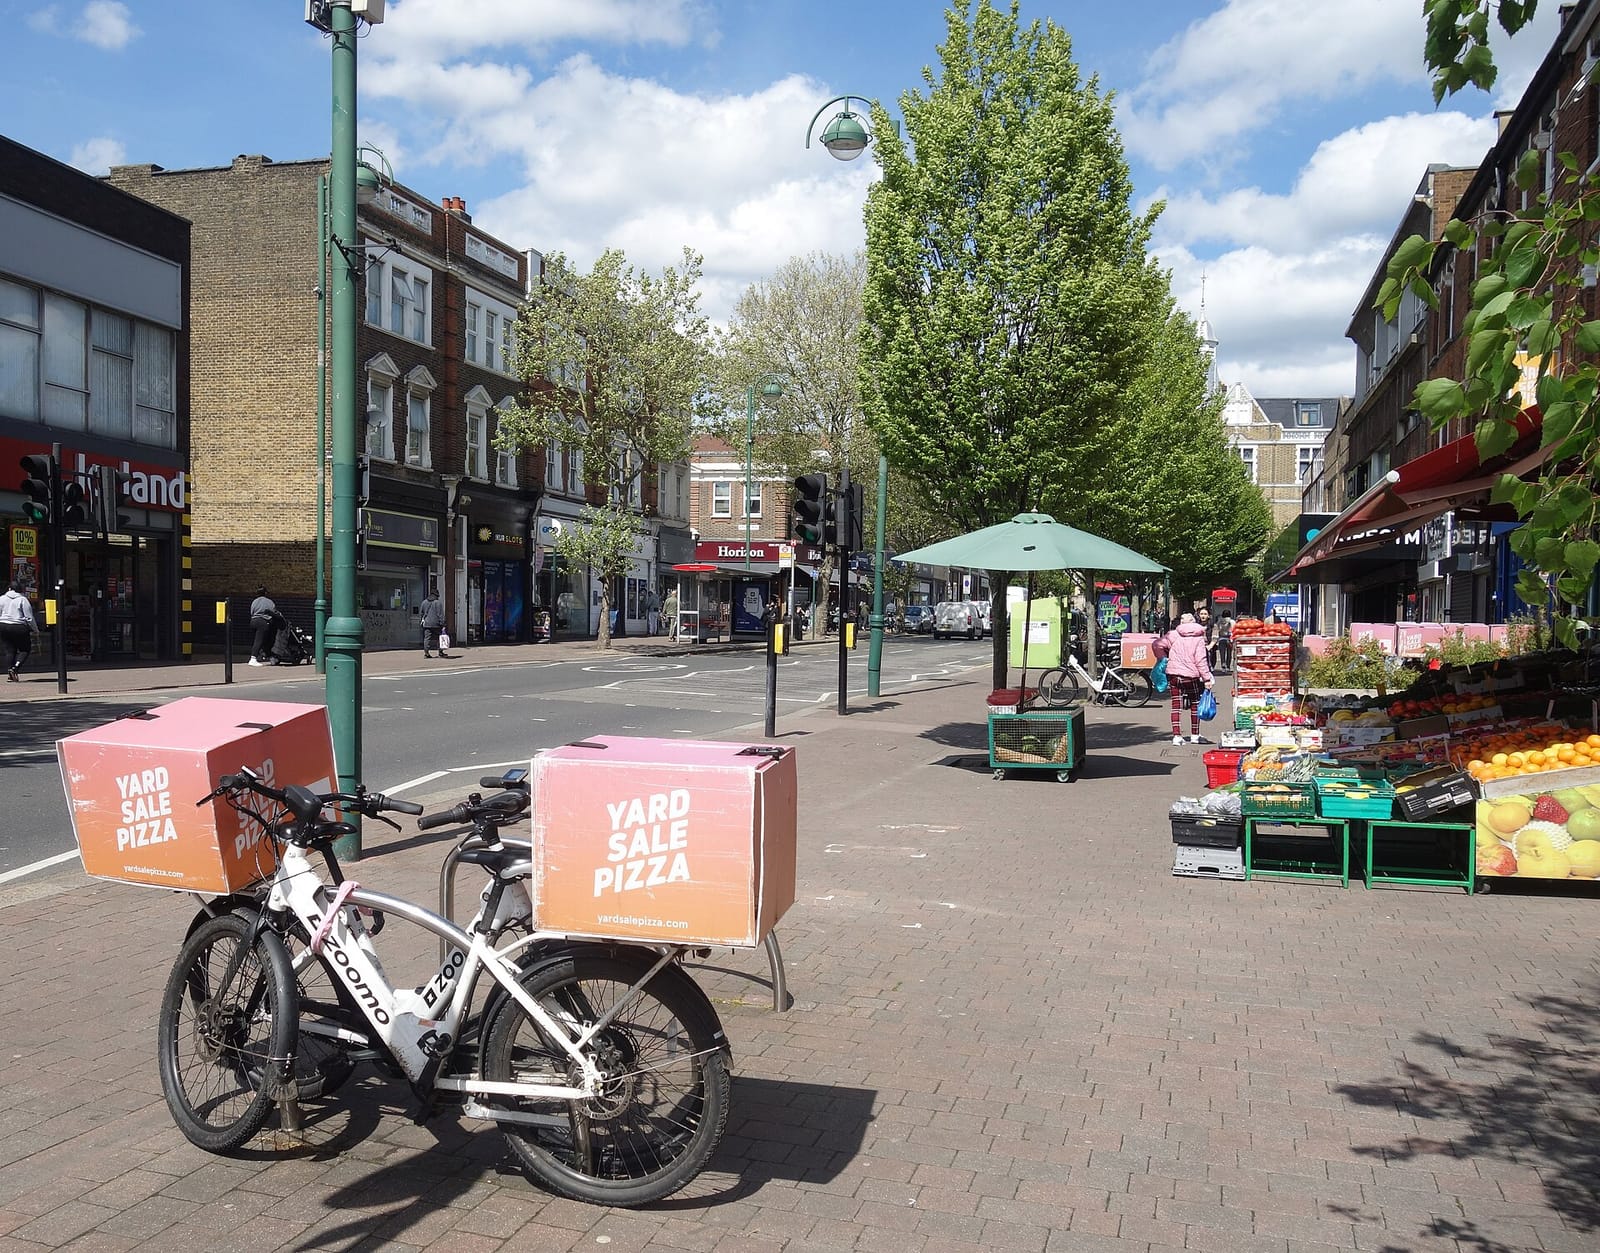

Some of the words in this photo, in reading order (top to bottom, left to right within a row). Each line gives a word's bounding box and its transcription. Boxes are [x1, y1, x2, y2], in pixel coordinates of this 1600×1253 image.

[15, 530, 34, 544] 10%
[115, 766, 169, 799] YARD
[121, 791, 172, 824] SALE
[606, 789, 691, 831] YARD
[116, 818, 178, 852] PIZZA
[607, 819, 689, 862] SALE
[124, 865, 184, 878] yardsalepizza.com
[593, 852, 691, 897] PIZZA
[597, 913, 689, 929] yardsalepizza.com
